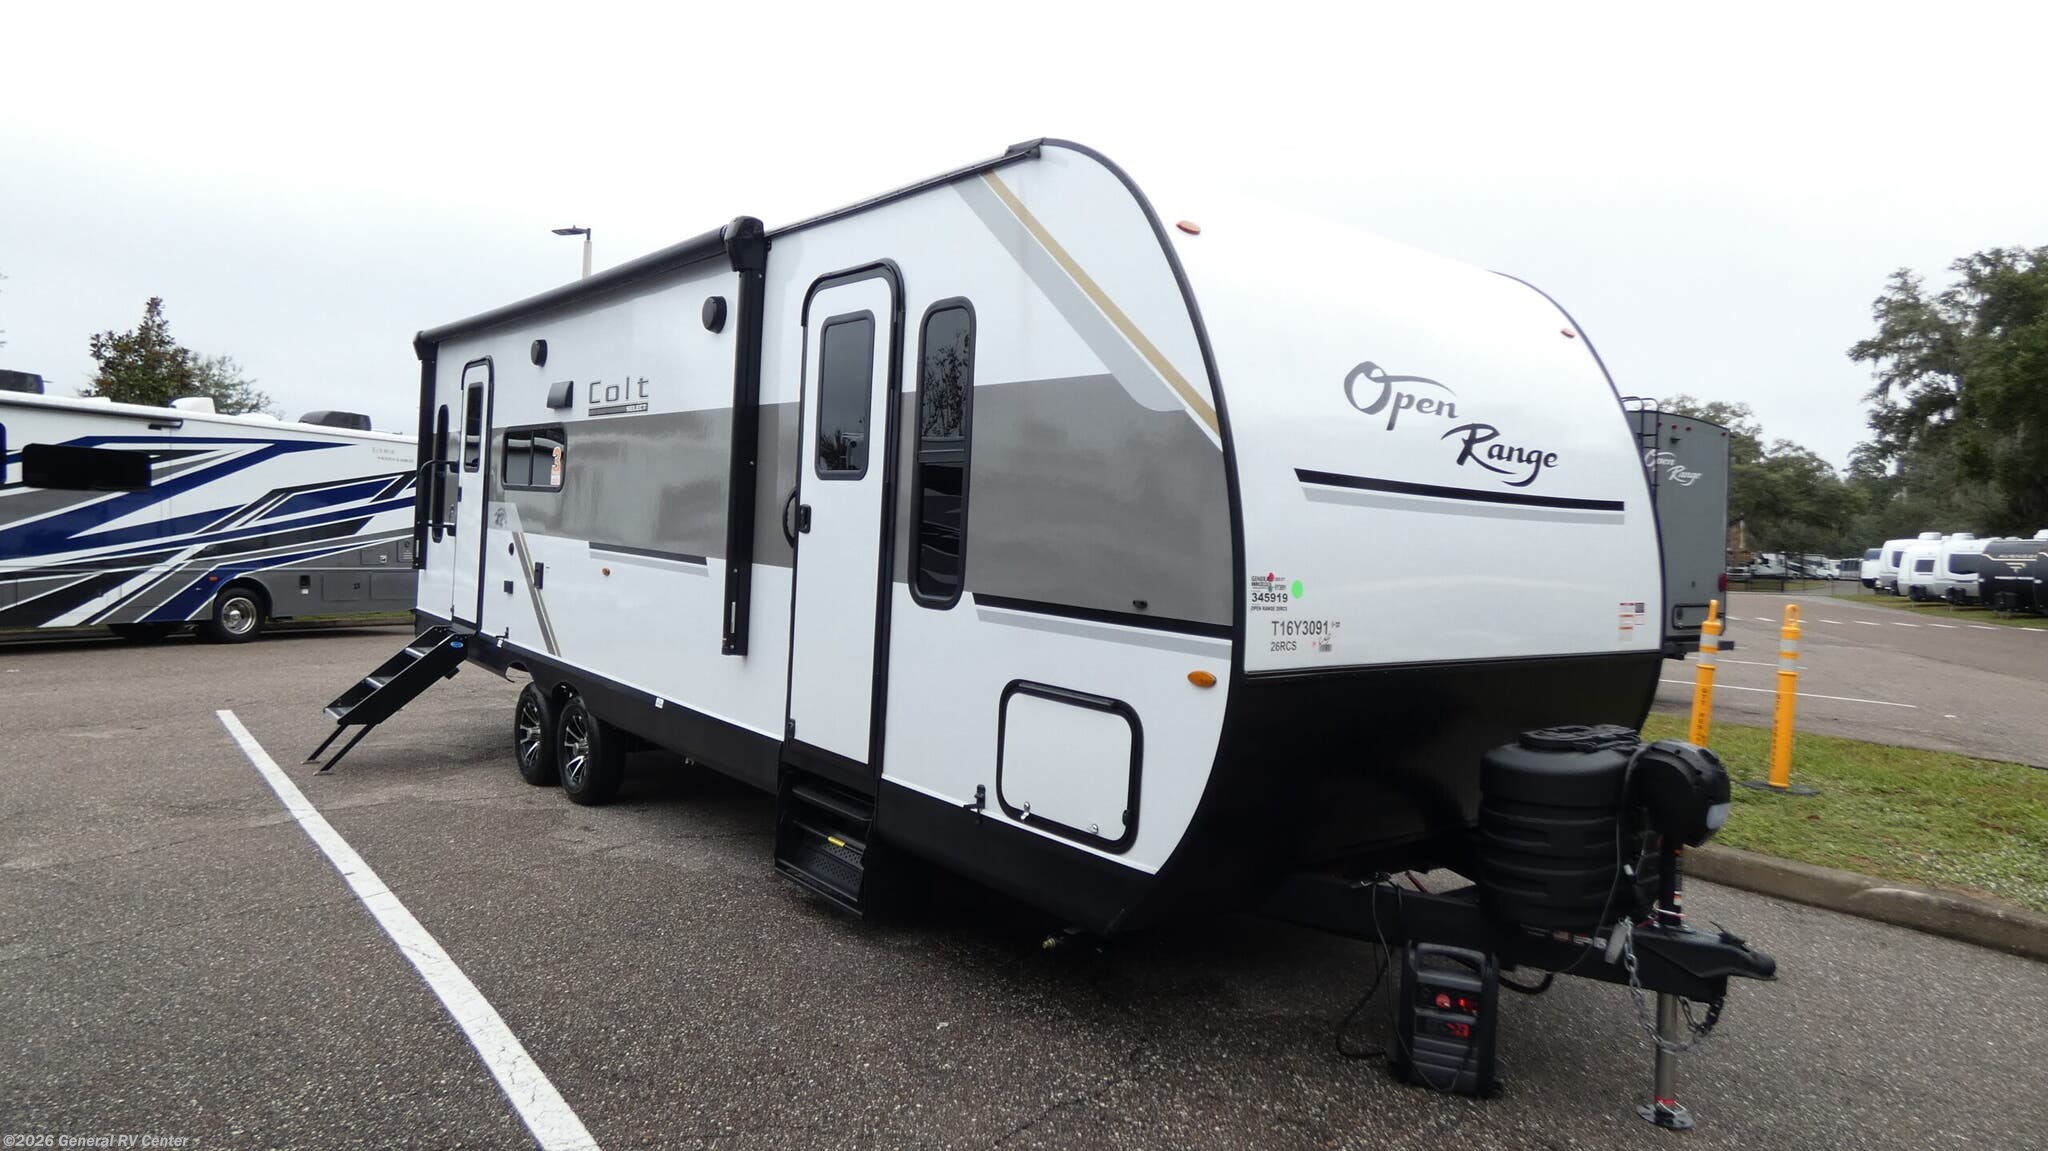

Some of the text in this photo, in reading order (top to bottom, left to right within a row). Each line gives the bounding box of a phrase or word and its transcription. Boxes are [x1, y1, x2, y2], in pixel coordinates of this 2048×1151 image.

[589, 377, 648, 404] Colt
[1344, 361, 1458, 431] Open
[1440, 423, 1558, 487] Range
[1251, 592, 1288, 602] 345919
[1271, 620, 1328, 636] T16Y3091
[1270, 640, 1297, 652] 26RCS
